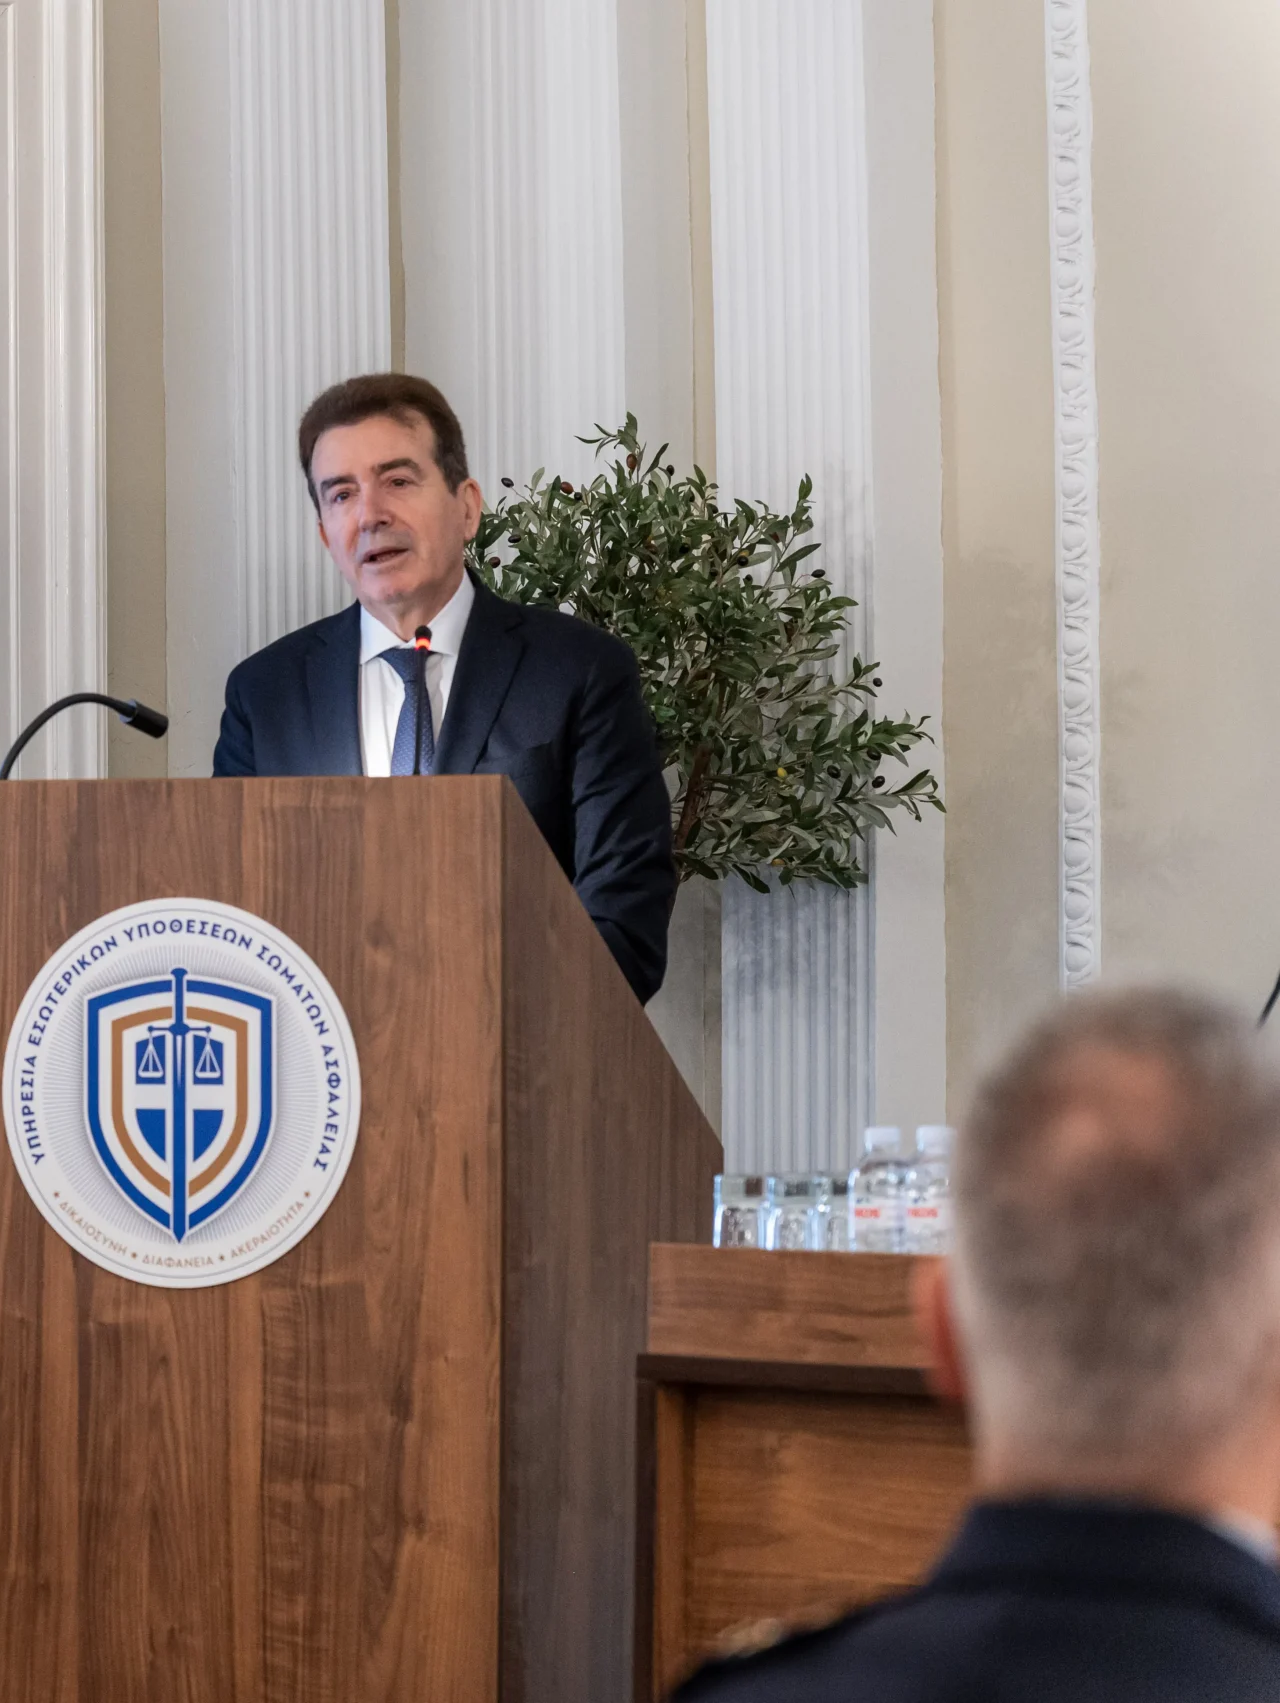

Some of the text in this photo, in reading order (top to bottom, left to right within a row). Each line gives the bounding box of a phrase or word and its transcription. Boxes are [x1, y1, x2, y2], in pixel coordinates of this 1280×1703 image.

[21, 919, 341, 1172] ΥΠΗΡΕΣΙΑ ΕΣΩΤΕΡΙΚΩΝ ΥΠΟΘΕΣΕΩΝ ΣΩΜΑΤΩΝ ΑΣΦΑΛΕΙΑΣ
[59, 1201, 305, 1269] ΔΙΚΑΙΟΣΥΝΗ ΔΙΑΦΑΝΕΙΑ ΑΚΕΡΑΙΟΤΗΤΑ
